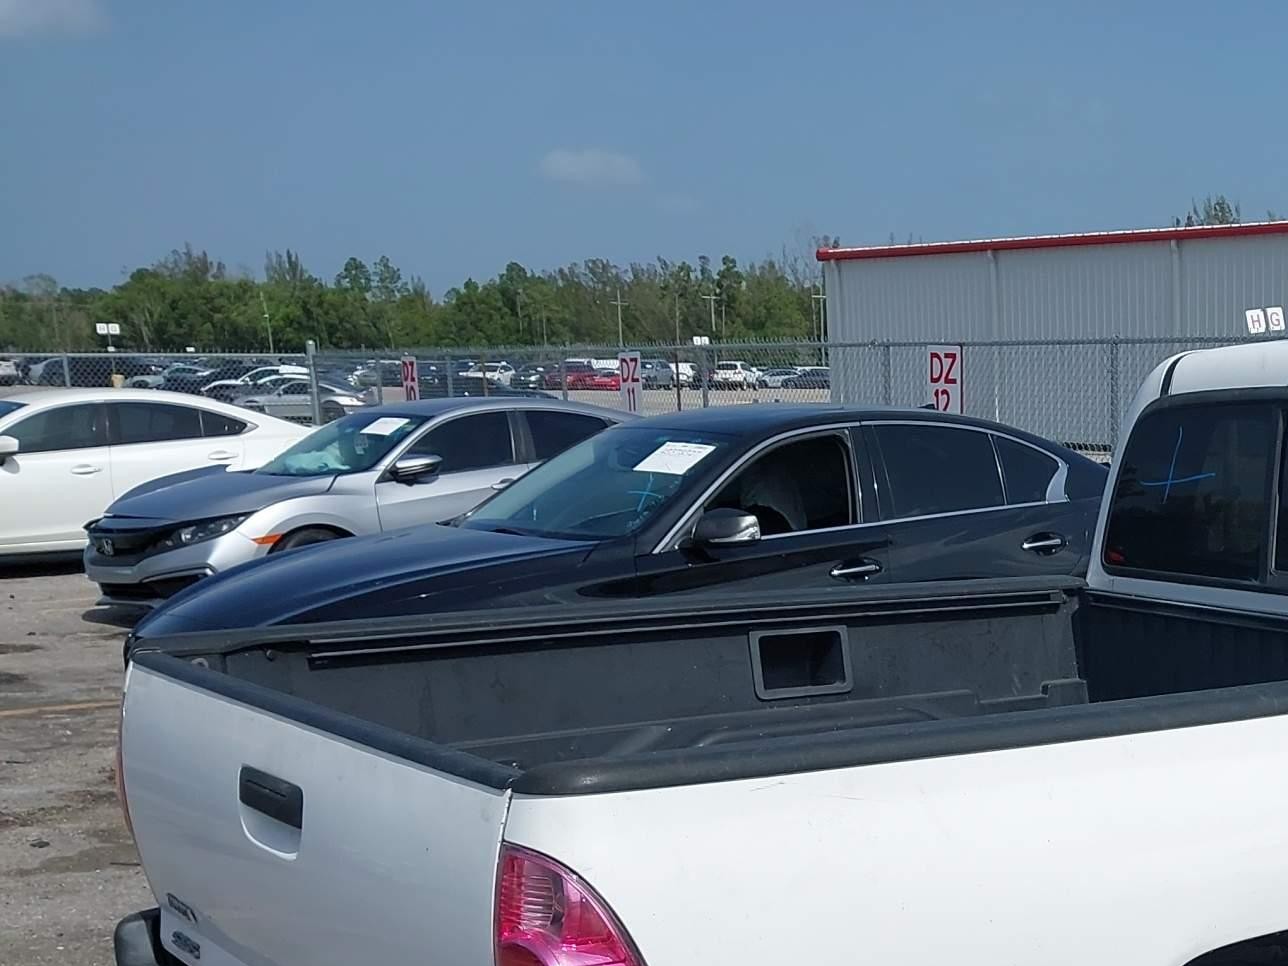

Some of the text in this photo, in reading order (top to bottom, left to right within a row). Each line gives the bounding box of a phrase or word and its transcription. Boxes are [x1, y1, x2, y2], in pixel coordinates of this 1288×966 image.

[1250, 311, 1281, 329] H G
[402, 360, 416, 382] DZ
[620, 358, 640, 383] DZ
[929, 352, 957, 384] DZ
[627, 387, 636, 412] 11
